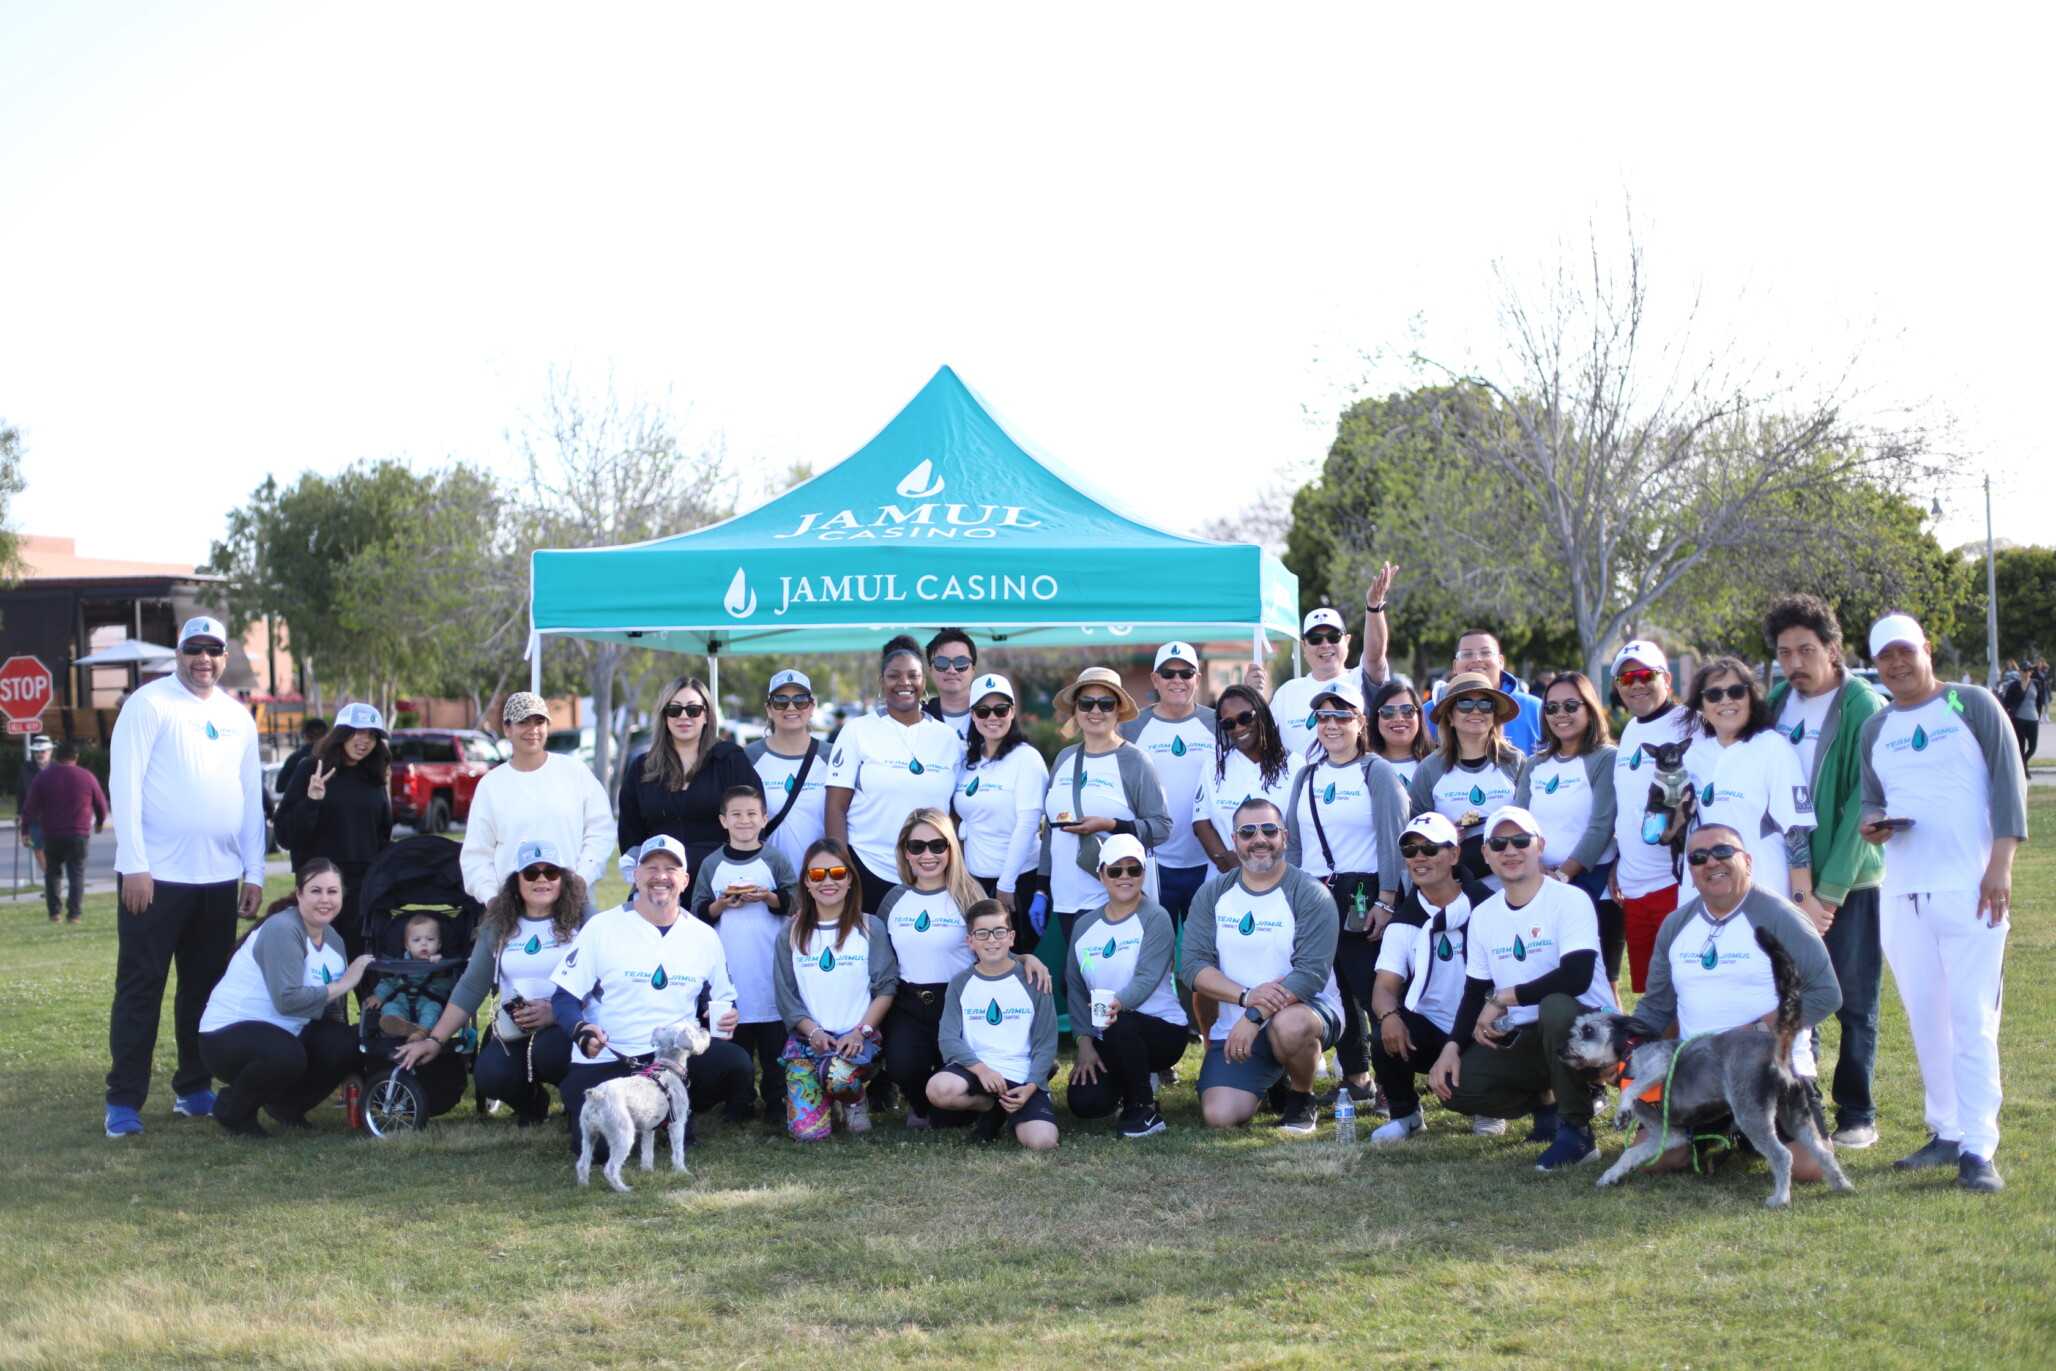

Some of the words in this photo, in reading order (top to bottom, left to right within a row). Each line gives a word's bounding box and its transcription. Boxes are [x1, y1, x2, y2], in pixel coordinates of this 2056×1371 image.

[772, 503, 1042, 539] JAMUL
[818, 527, 997, 541] CASINO
[773, 574, 907, 616] JAMUL
[916, 574, 1059, 601] CASINO
[0, 676, 48, 702] STOP
[1148, 742, 1171, 750] TEAM
[1187, 742, 1215, 750] JAMUL
[1885, 737, 1911, 749] TEAM
[894, 916, 915, 924] TEAM
[931, 917, 961, 925] JAMUL
[1216, 915, 1240, 924] TEAM
[1255, 920, 1284, 928] JAMUL
[1491, 947, 1512, 955] TEAM
[1527, 939, 1553, 949] JAMUL
[797, 954, 819, 962] TEAM
[624, 970, 652, 978] TEAM
[669, 974, 697, 983] JAMUL
[964, 1007, 986, 1015] TEAM
